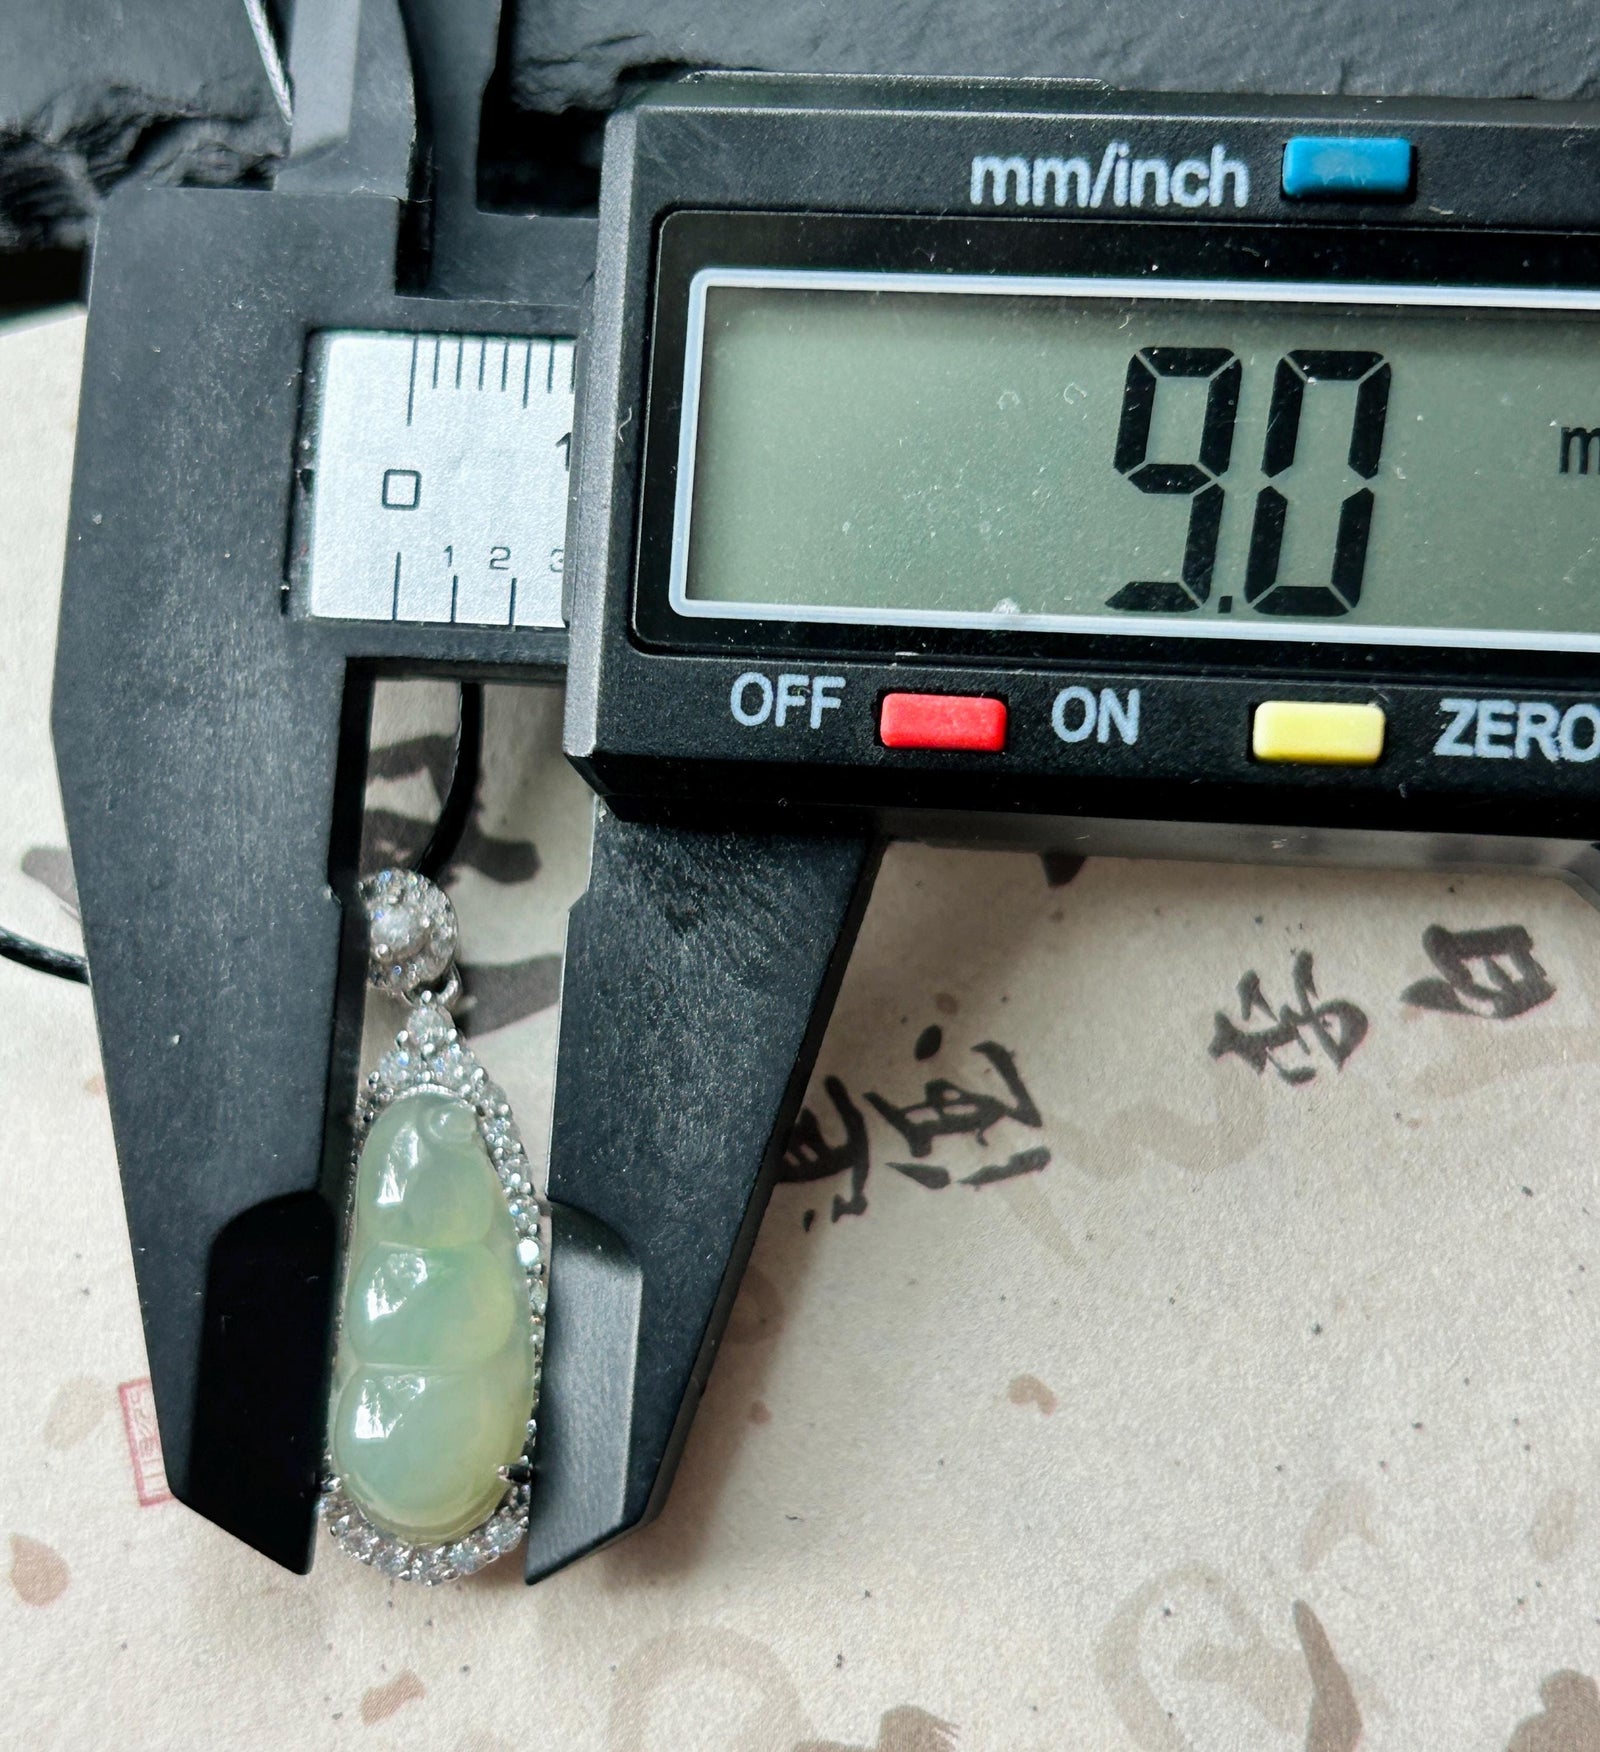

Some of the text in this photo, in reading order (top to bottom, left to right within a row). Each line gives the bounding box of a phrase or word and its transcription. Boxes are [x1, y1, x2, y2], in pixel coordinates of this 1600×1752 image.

[969, 138, 1250, 209] mm/inch
[1103, 346, 1392, 617] 9.0
[443, 544, 454, 568] 1
[488, 545, 512, 571] 2
[729, 671, 1600, 763] OFF ON ZERO
